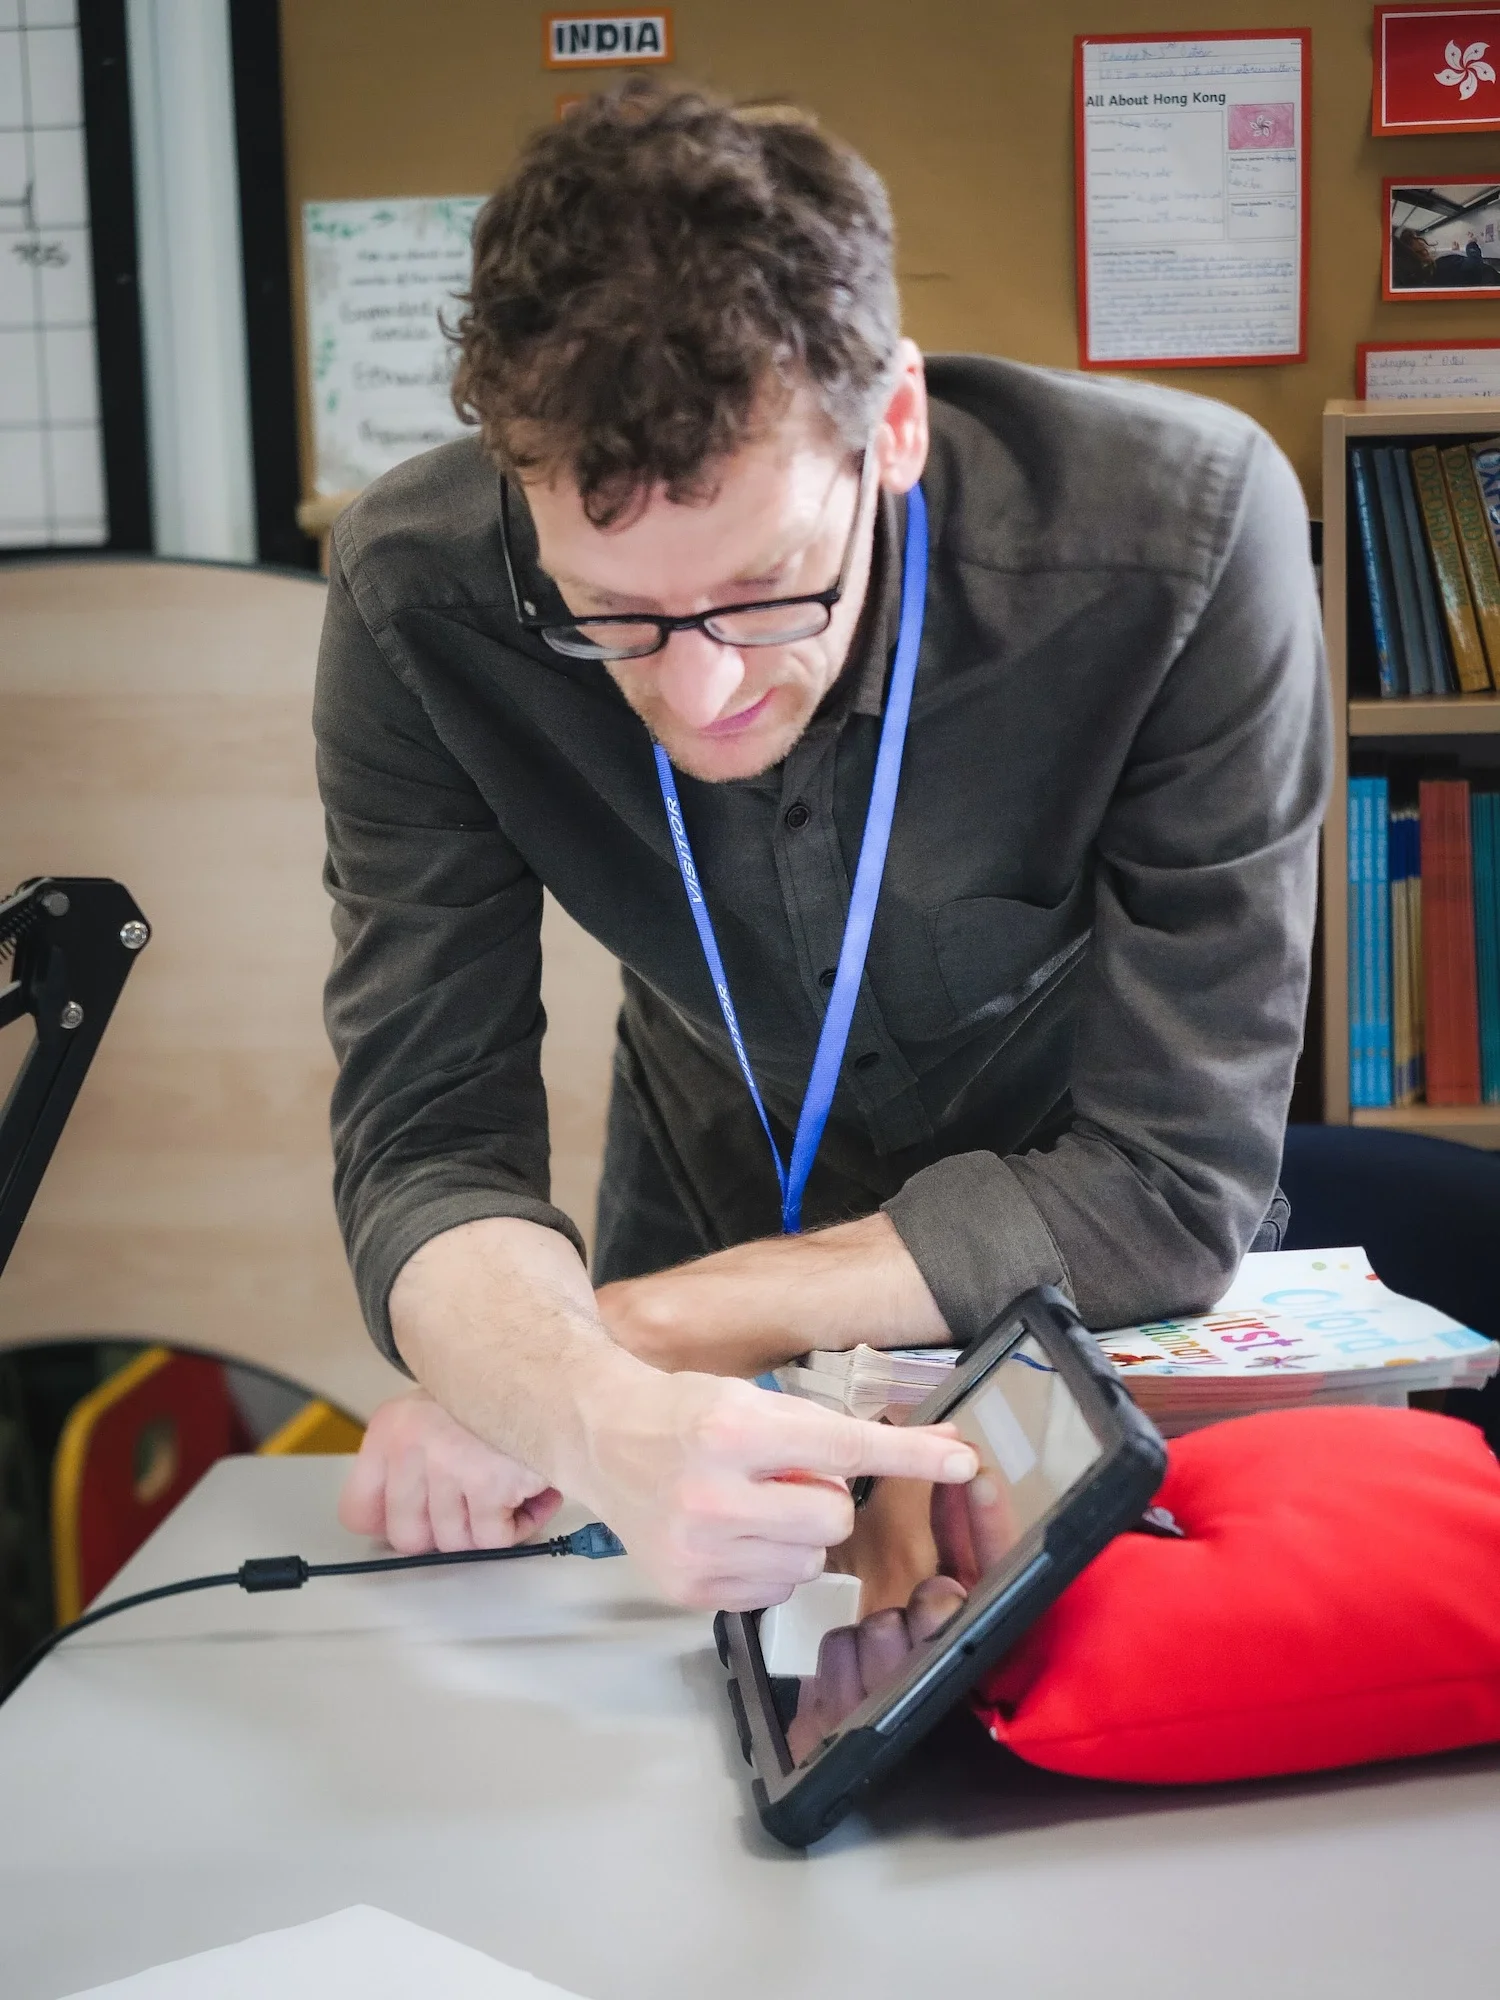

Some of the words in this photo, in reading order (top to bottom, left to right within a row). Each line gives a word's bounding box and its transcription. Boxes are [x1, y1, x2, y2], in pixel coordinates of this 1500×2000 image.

[1086, 95, 1105, 107] All
[1108, 95, 1149, 106] About
[1153, 93, 1188, 106] Hong
[1192, 91, 1226, 105] Kong
[1415, 454, 1452, 542] OXFORD
[1446, 452, 1485, 542] OXFORD
[666, 796, 703, 903] VISITOR
[717, 983, 754, 1088] VISITOR
[1139, 1319, 1228, 1365] tionary
[1190, 1308, 1304, 1352] First
